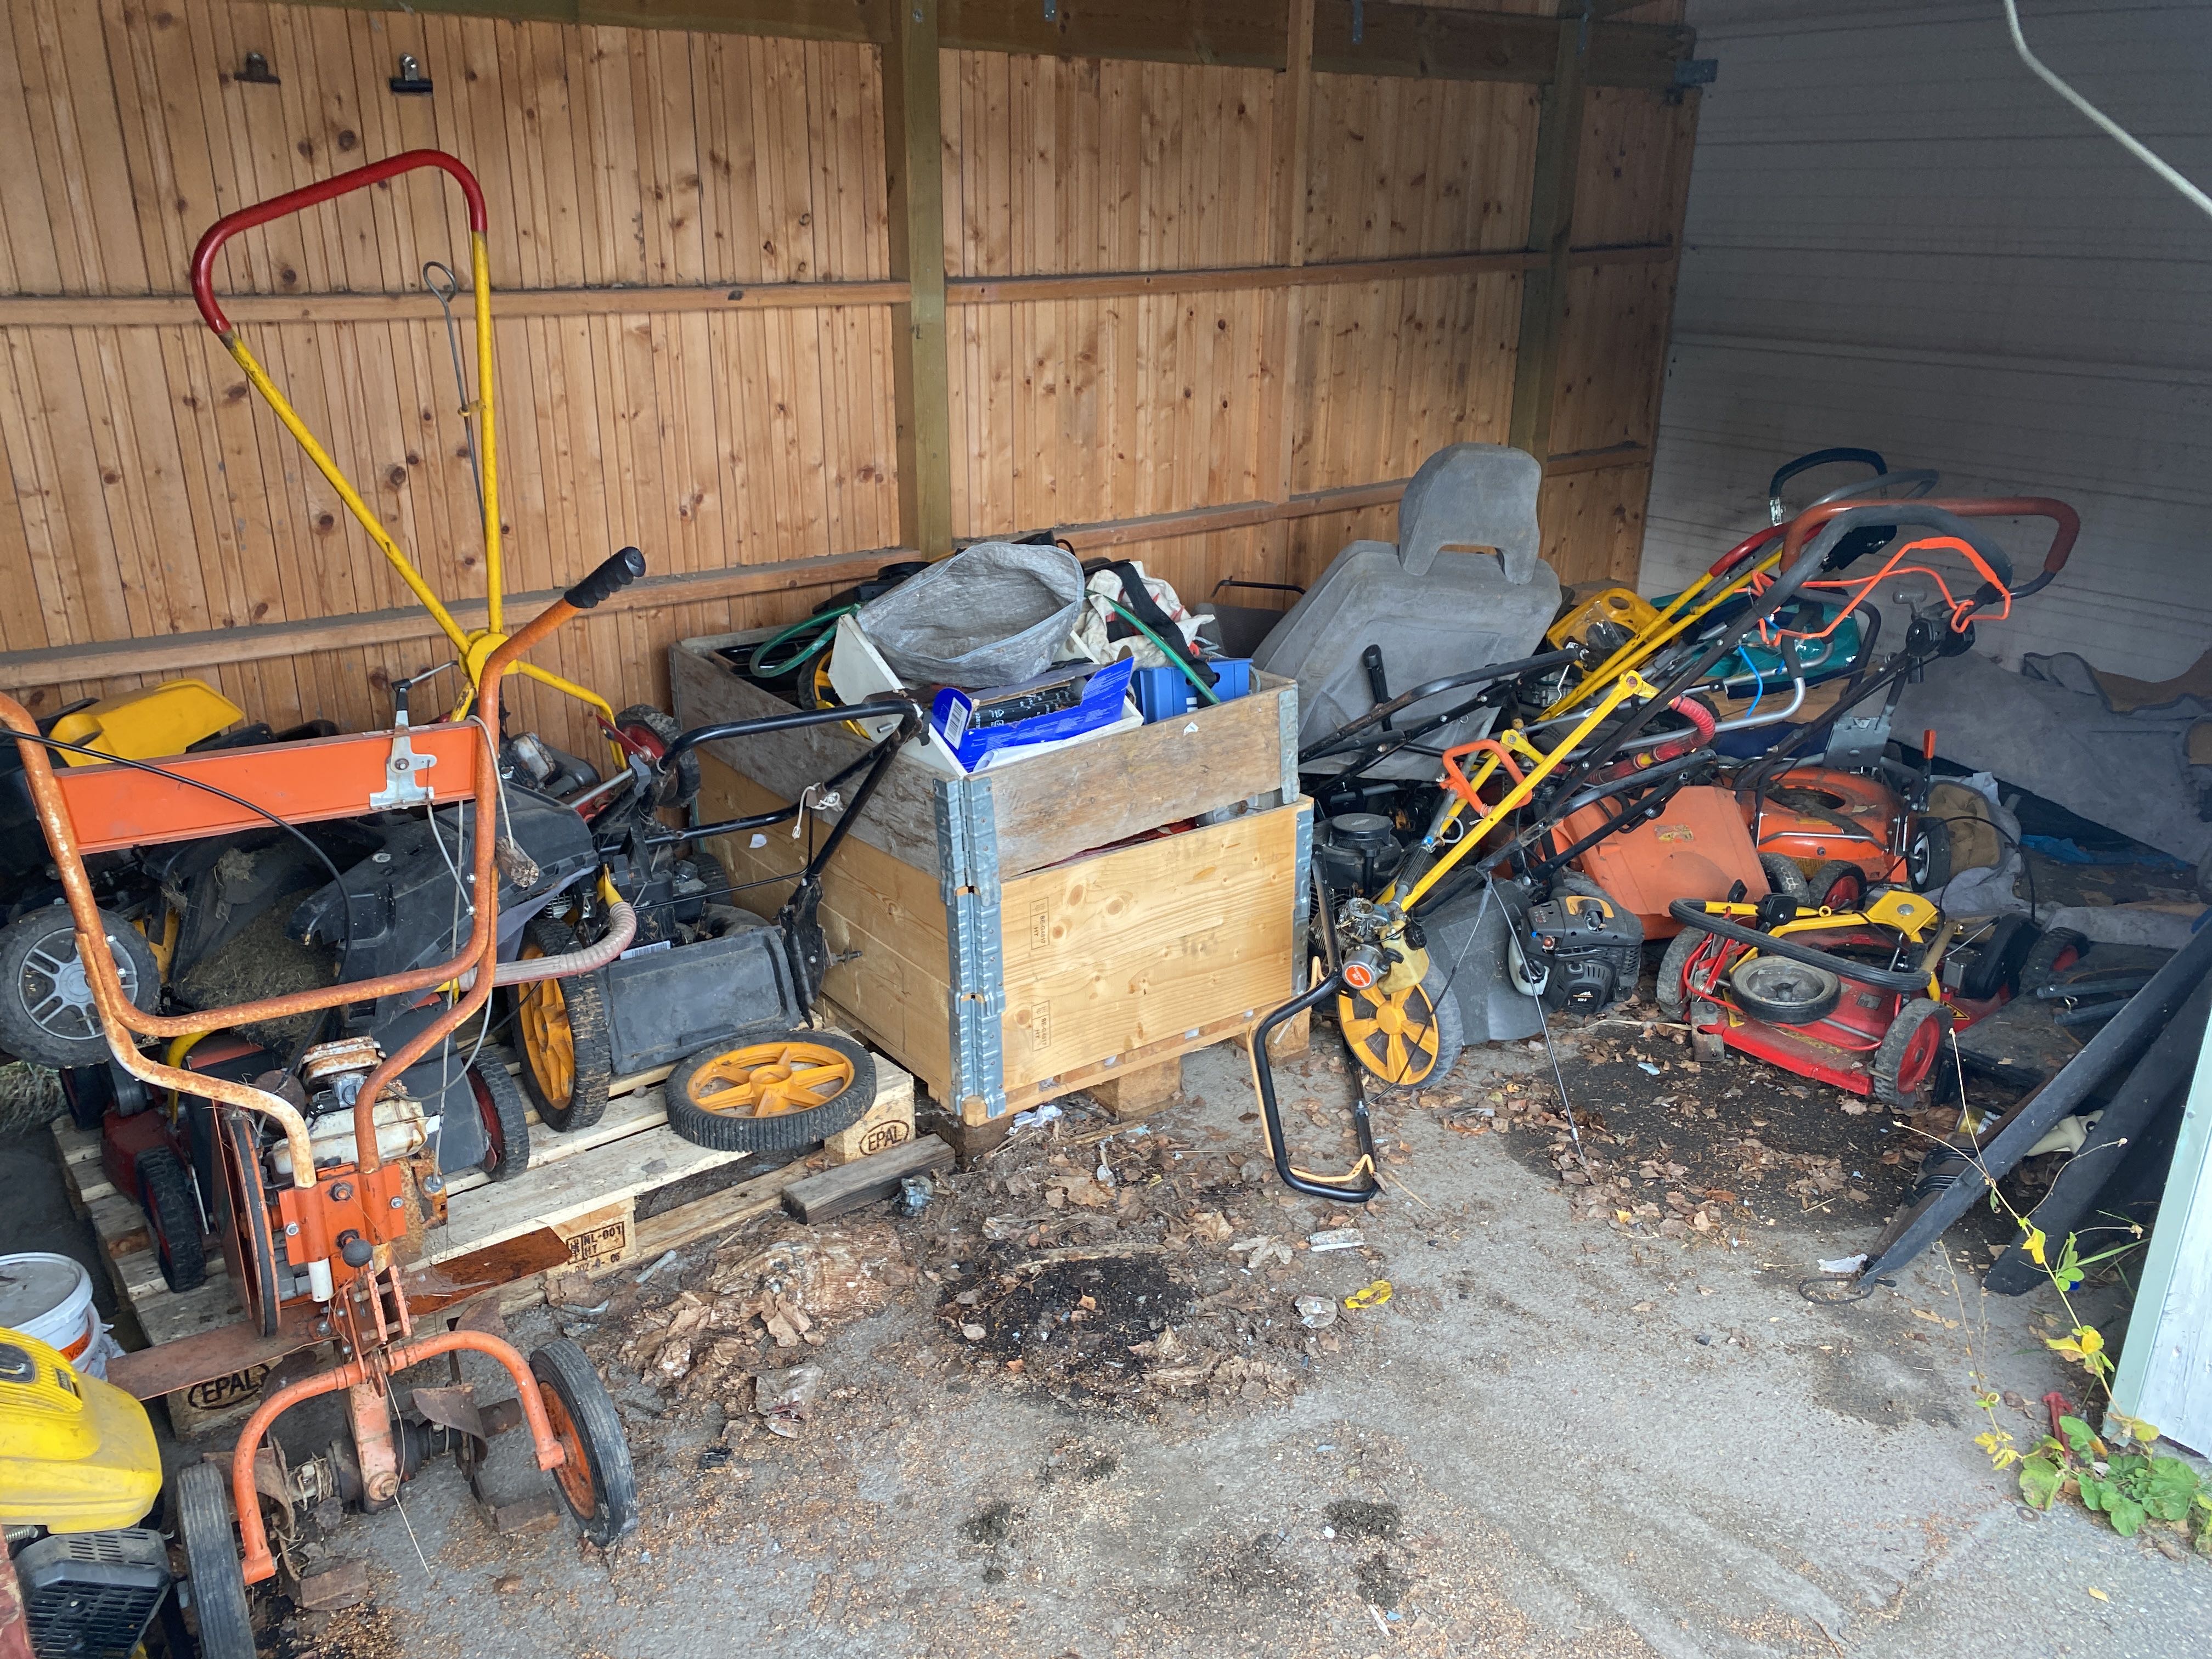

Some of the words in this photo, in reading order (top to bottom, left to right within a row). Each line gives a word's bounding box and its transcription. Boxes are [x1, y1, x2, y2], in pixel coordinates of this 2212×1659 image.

[1033, 927, 1039, 936] HT
[1035, 1029, 1040, 1039] HT
[868, 1126, 902, 1151] EPAL
[584, 1224, 621, 1245] NL-001
[584, 1244, 597, 1257] HT
[201, 1369, 259, 1403] EPAL
